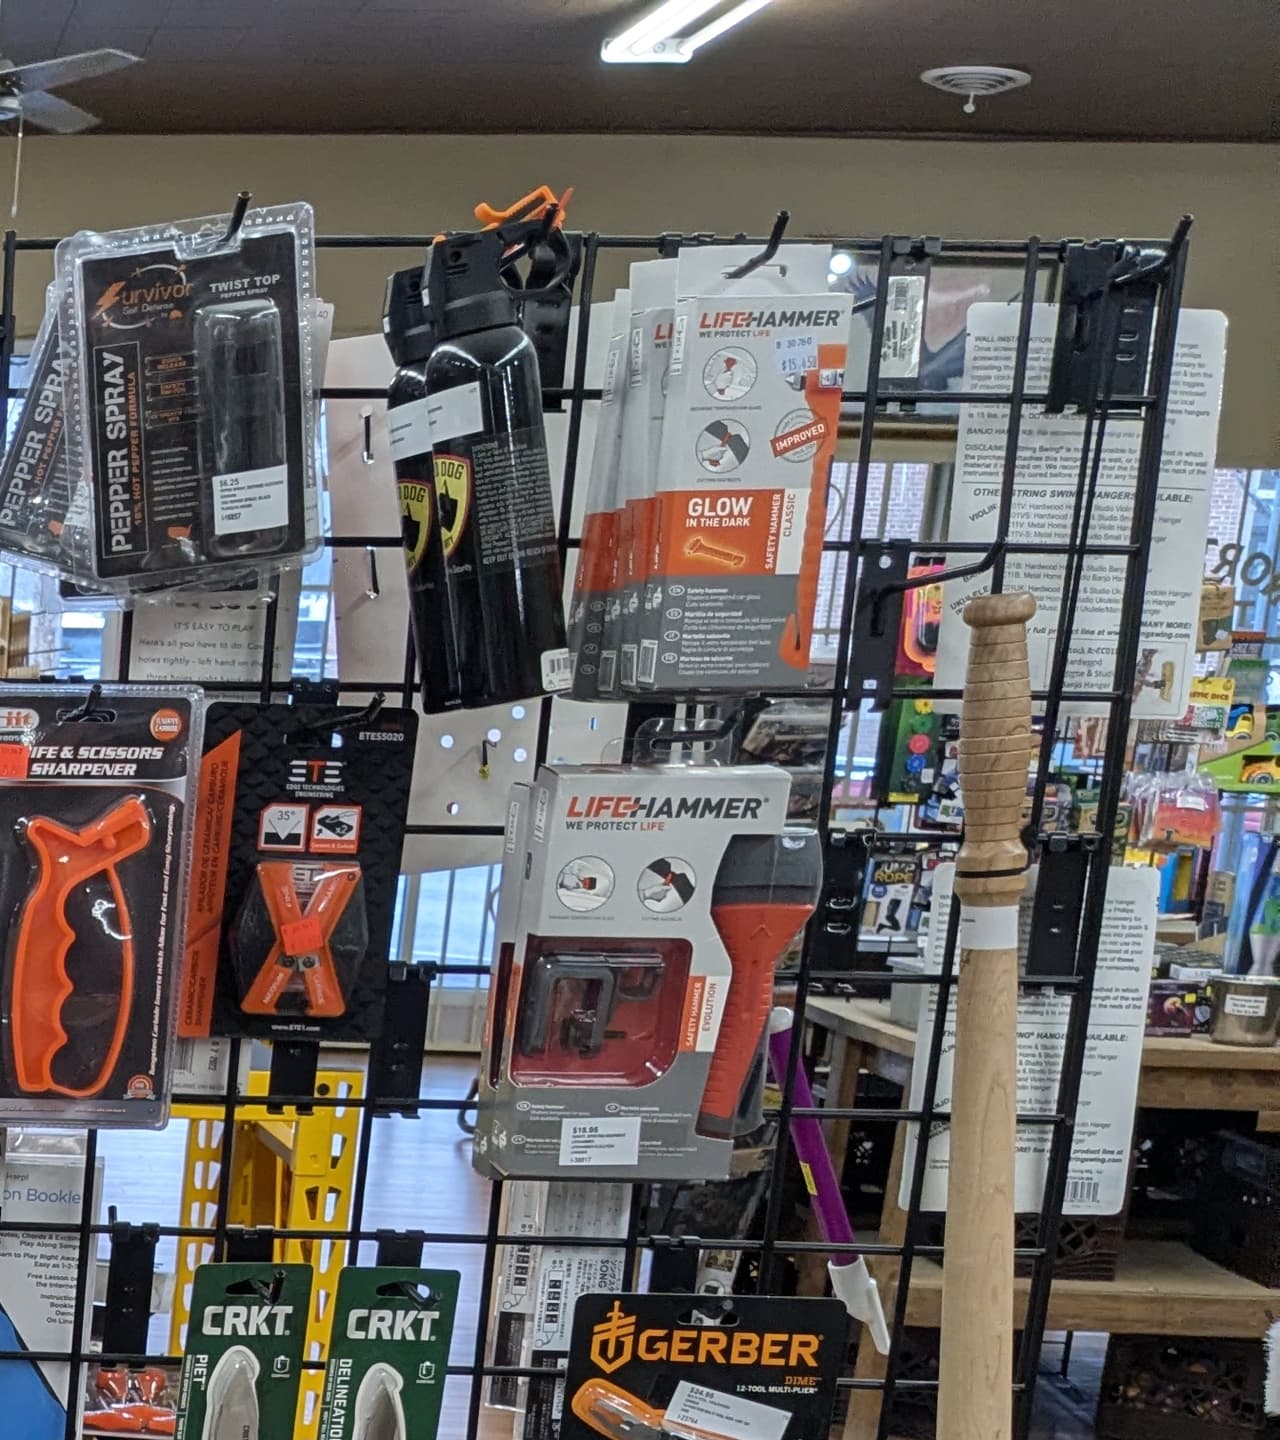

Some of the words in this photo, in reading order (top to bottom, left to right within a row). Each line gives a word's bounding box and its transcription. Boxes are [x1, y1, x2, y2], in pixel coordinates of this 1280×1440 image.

[209, 277, 250, 293] TWIST
[253, 273, 280, 286] TOP
[103, 351, 128, 439] SPRAY
[128, 372, 138, 433] FORMULA
[775, 423, 825, 452] IMPROVED
[440, 461, 464, 480] DOG
[107, 449, 132, 551] PEPPER
[403, 485, 426, 503] DOG
[688, 496, 754, 516] GLOW
[686, 518, 696, 528] IN
[700, 518, 720, 527] THE
[722, 518, 750, 527] DARK
[769, 494, 782, 533] HAMMER
[782, 493, 796, 537] CLASSIC
[765, 535, 776, 570] SAFETY
[31, 746, 58, 758] IFE
[60, 746, 74, 758] &
[76, 747, 164, 760] SCISSORS
[30, 763, 137, 776] SHARPENER
[566, 821, 584, 830] WE
[586, 821, 636, 831] PROTECT
[640, 822, 665, 832] LIFE
[875, 872, 913, 882] ROPE
[702, 982, 716, 1032] EVOLUTION
[27, 1188, 81, 1204] Bookle
[202, 1305, 294, 1336] CRKT
[346, 1308, 440, 1342] CRKT
[637, 1329, 819, 1368] GERBER
